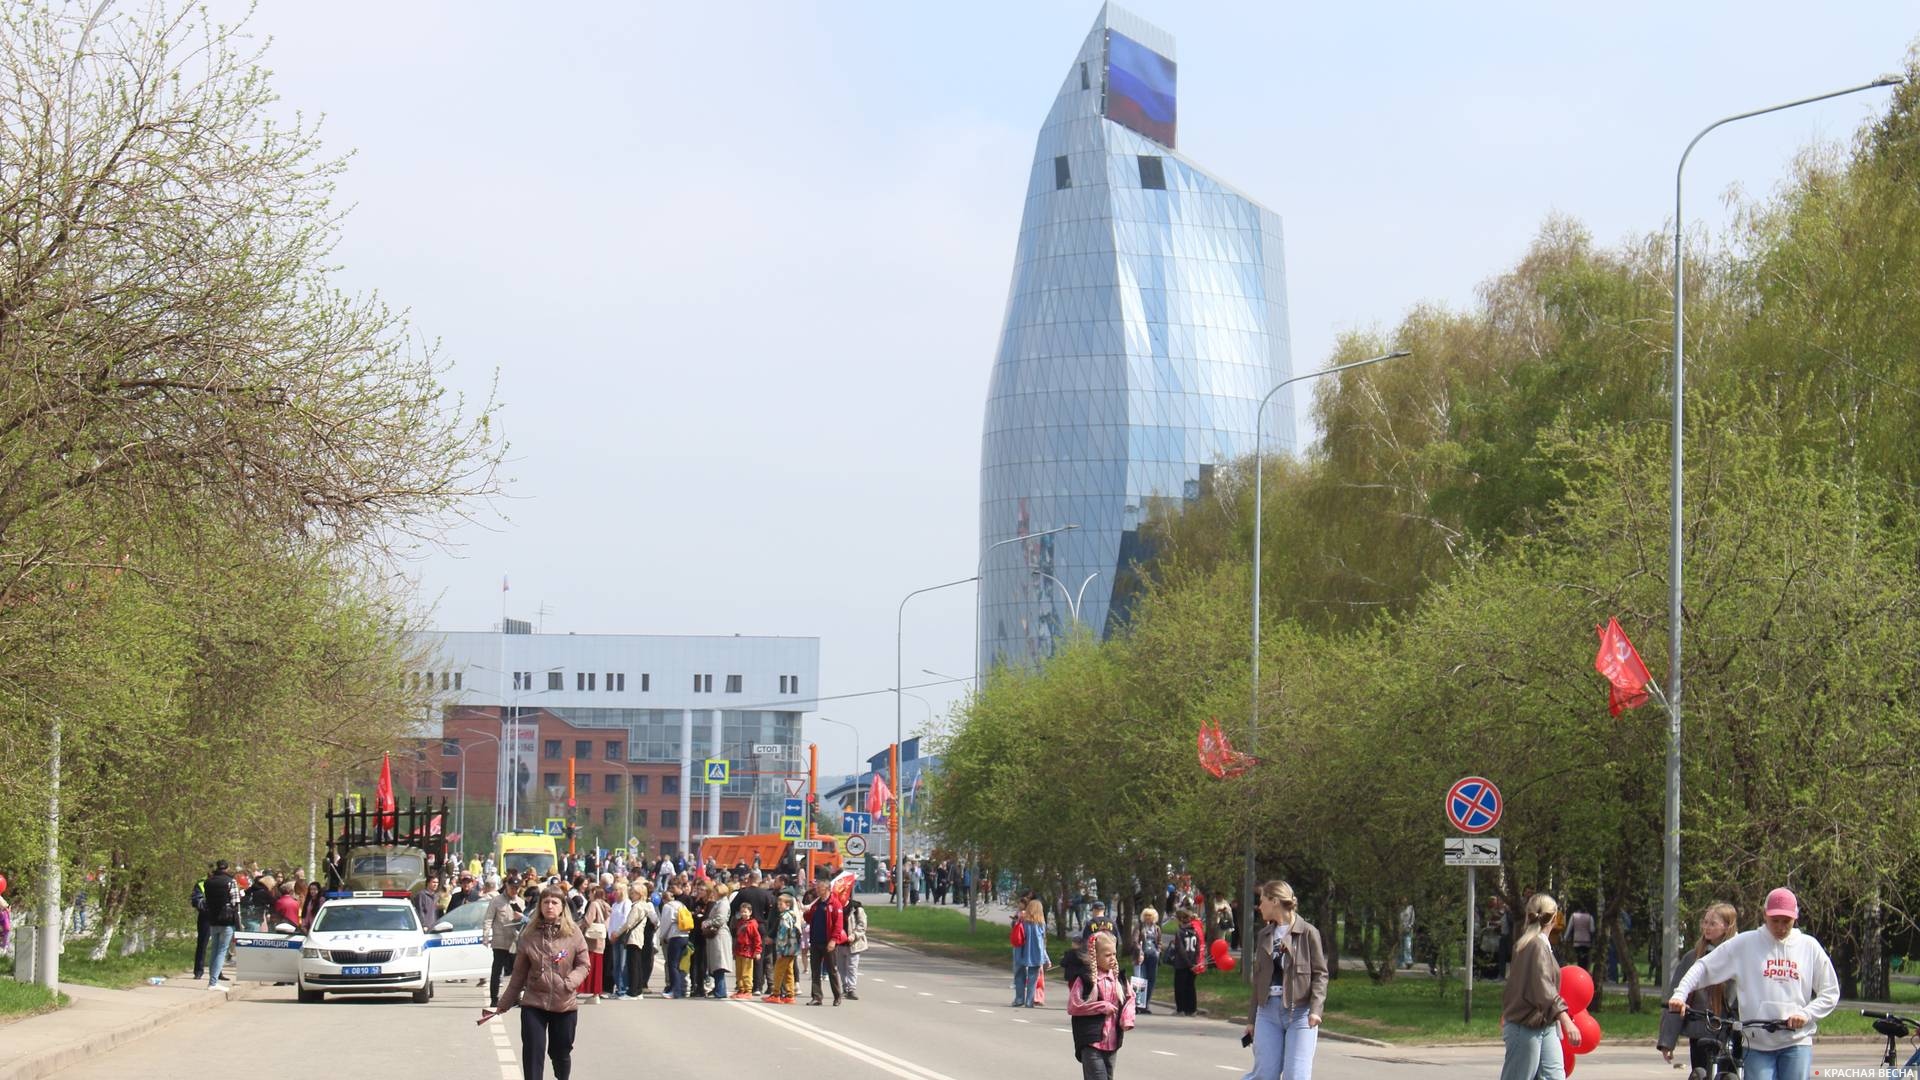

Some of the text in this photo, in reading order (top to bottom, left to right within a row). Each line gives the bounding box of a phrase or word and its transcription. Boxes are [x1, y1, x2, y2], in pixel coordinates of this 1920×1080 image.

[252, 939, 289, 948] ПОЛИЦИЯ
[441, 936, 479, 946] ПОЛИЦИЯ
[1767, 959, 1798, 970] puma
[1763, 968, 1799, 980] sports
